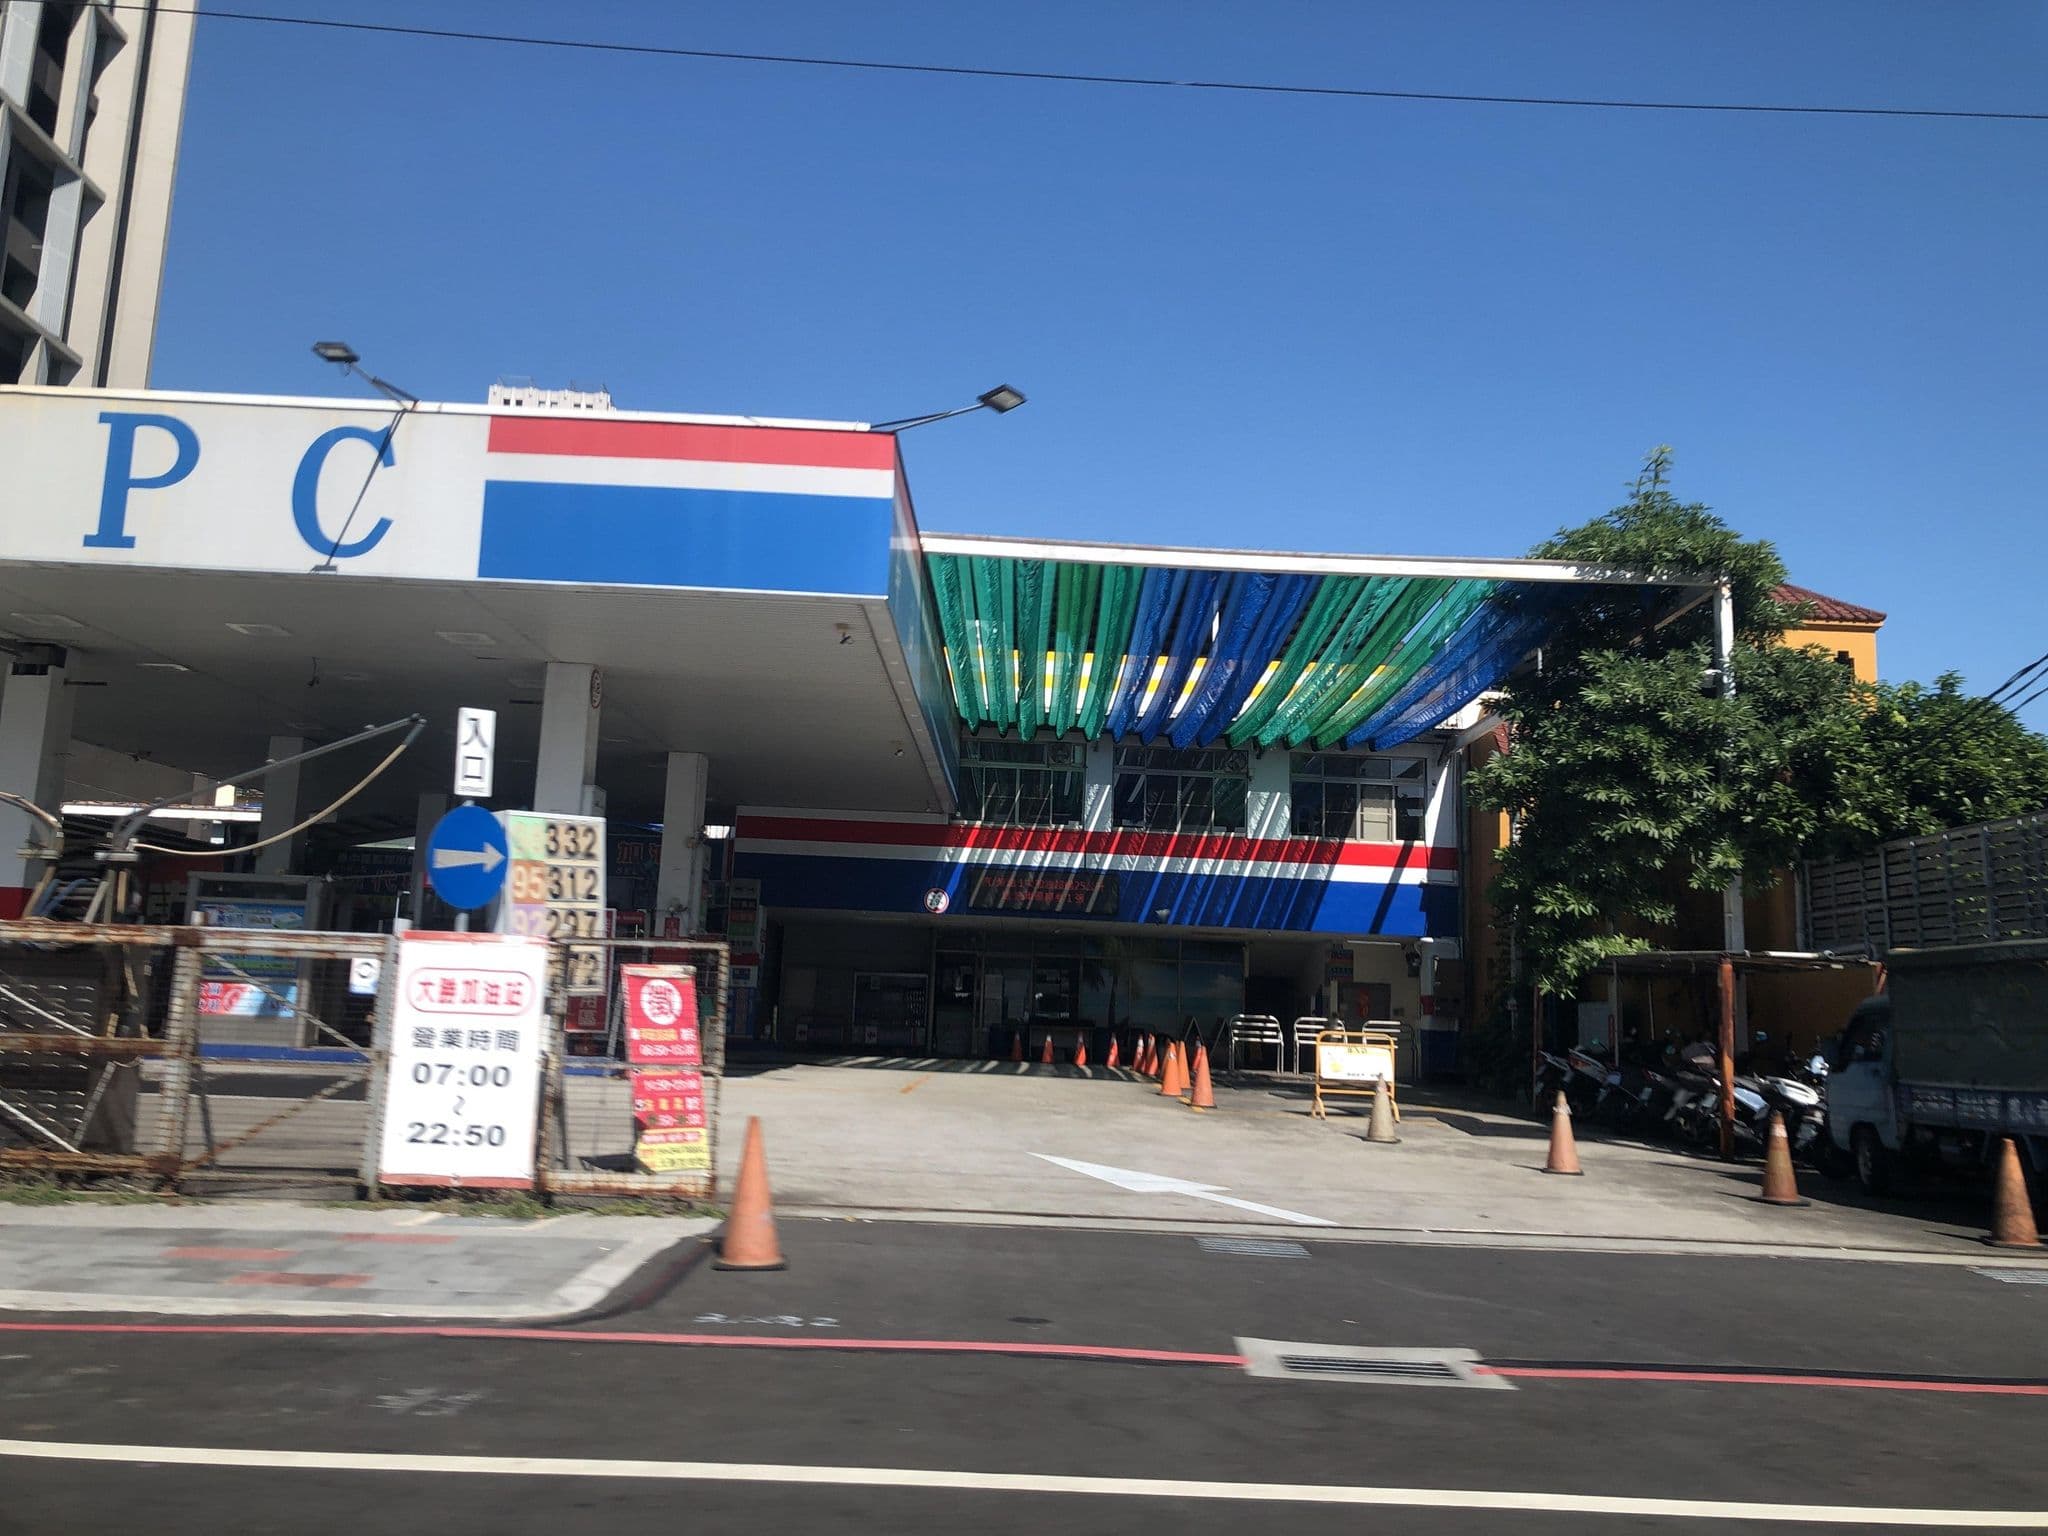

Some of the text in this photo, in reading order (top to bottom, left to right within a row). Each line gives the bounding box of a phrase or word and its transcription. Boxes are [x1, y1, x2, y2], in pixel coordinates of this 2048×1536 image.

[461, 717, 489, 782] 入口
[512, 864, 598, 900] 95 312
[411, 1026, 521, 1053] 營業時間
[412, 1062, 512, 1088] 07:00
[406, 1121, 507, 1147] 22:50
